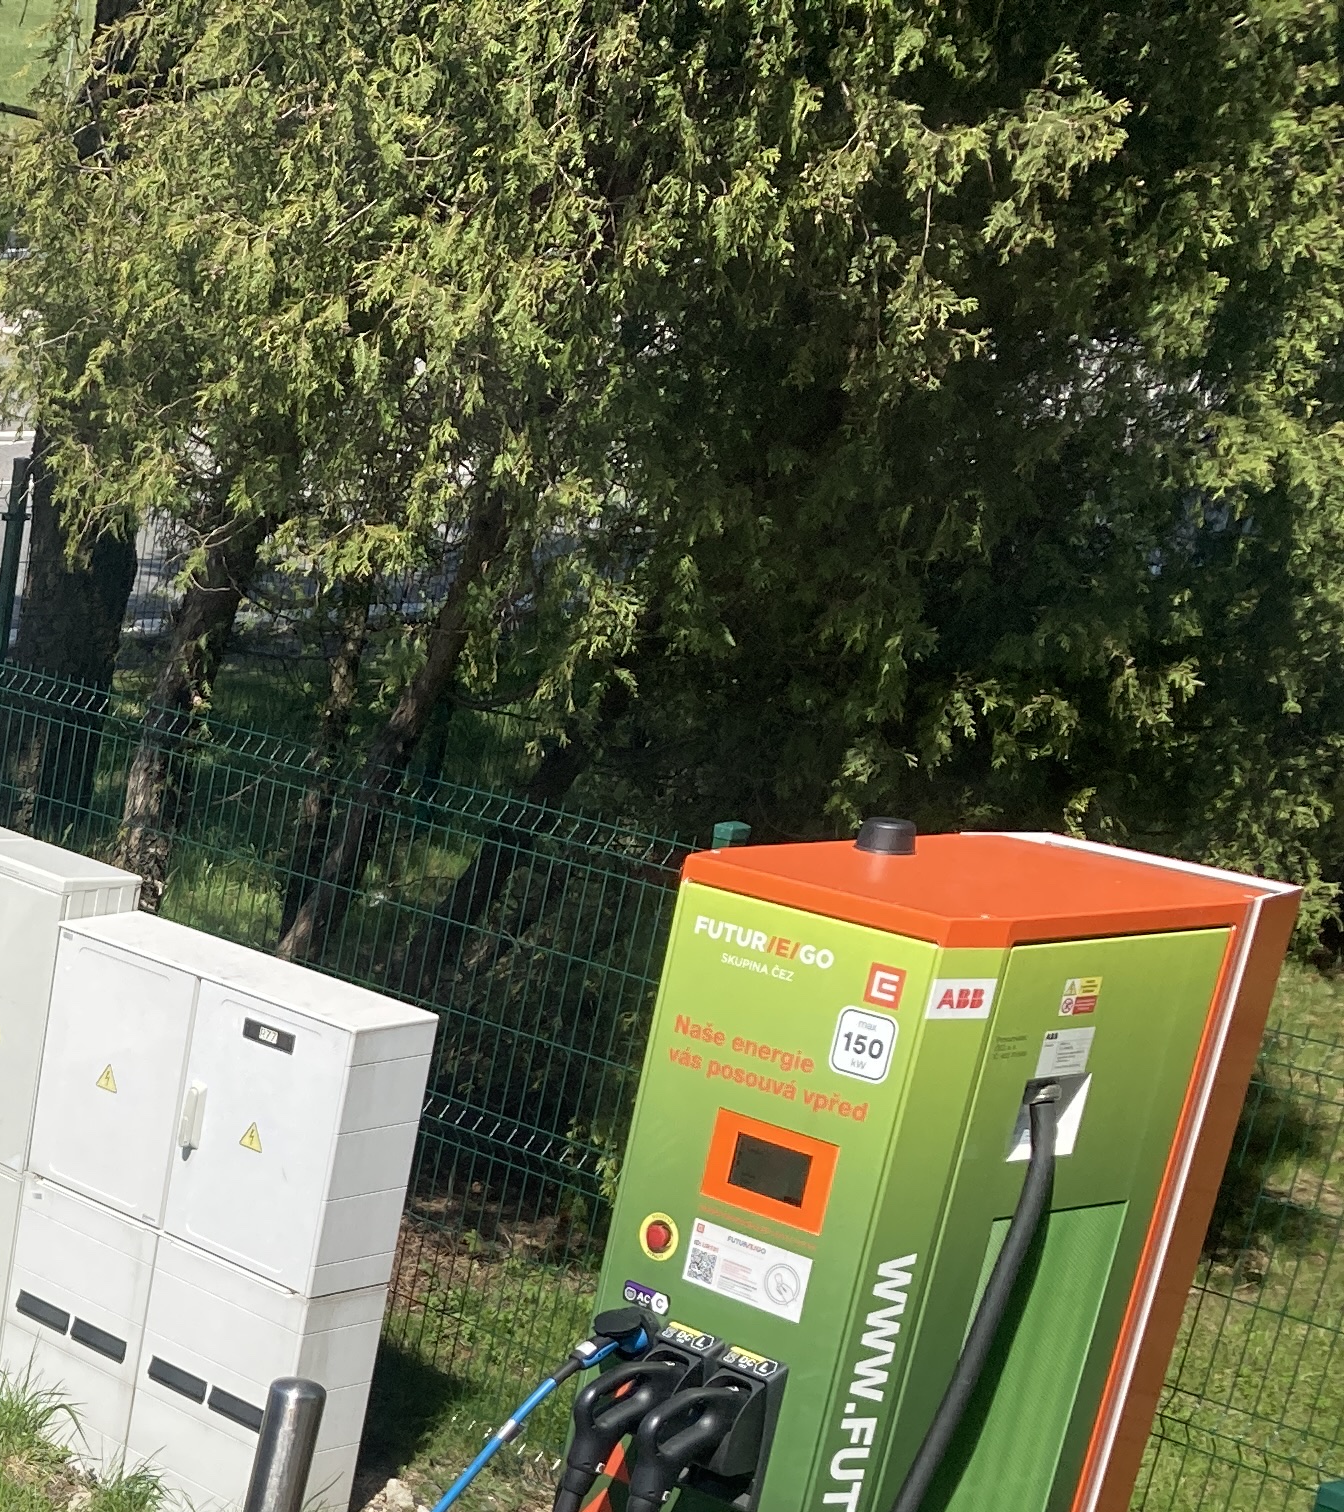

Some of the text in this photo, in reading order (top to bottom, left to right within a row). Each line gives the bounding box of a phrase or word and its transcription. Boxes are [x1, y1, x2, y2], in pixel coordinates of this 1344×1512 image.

[721, 953, 795, 982] SKUPINA ČEZ
[937, 988, 984, 1009] ABB
[858, 1020, 877, 1032] max
[674, 1014, 815, 1073] Naše energie
[843, 1031, 884, 1059] 150
[850, 1058, 867, 1069] kW
[669, 1047, 869, 1122] vás posouvá vpřed
[636, 1291, 651, 1304] AC
[676, 1330, 693, 1341] DC
[738, 1355, 756, 1367] DC
